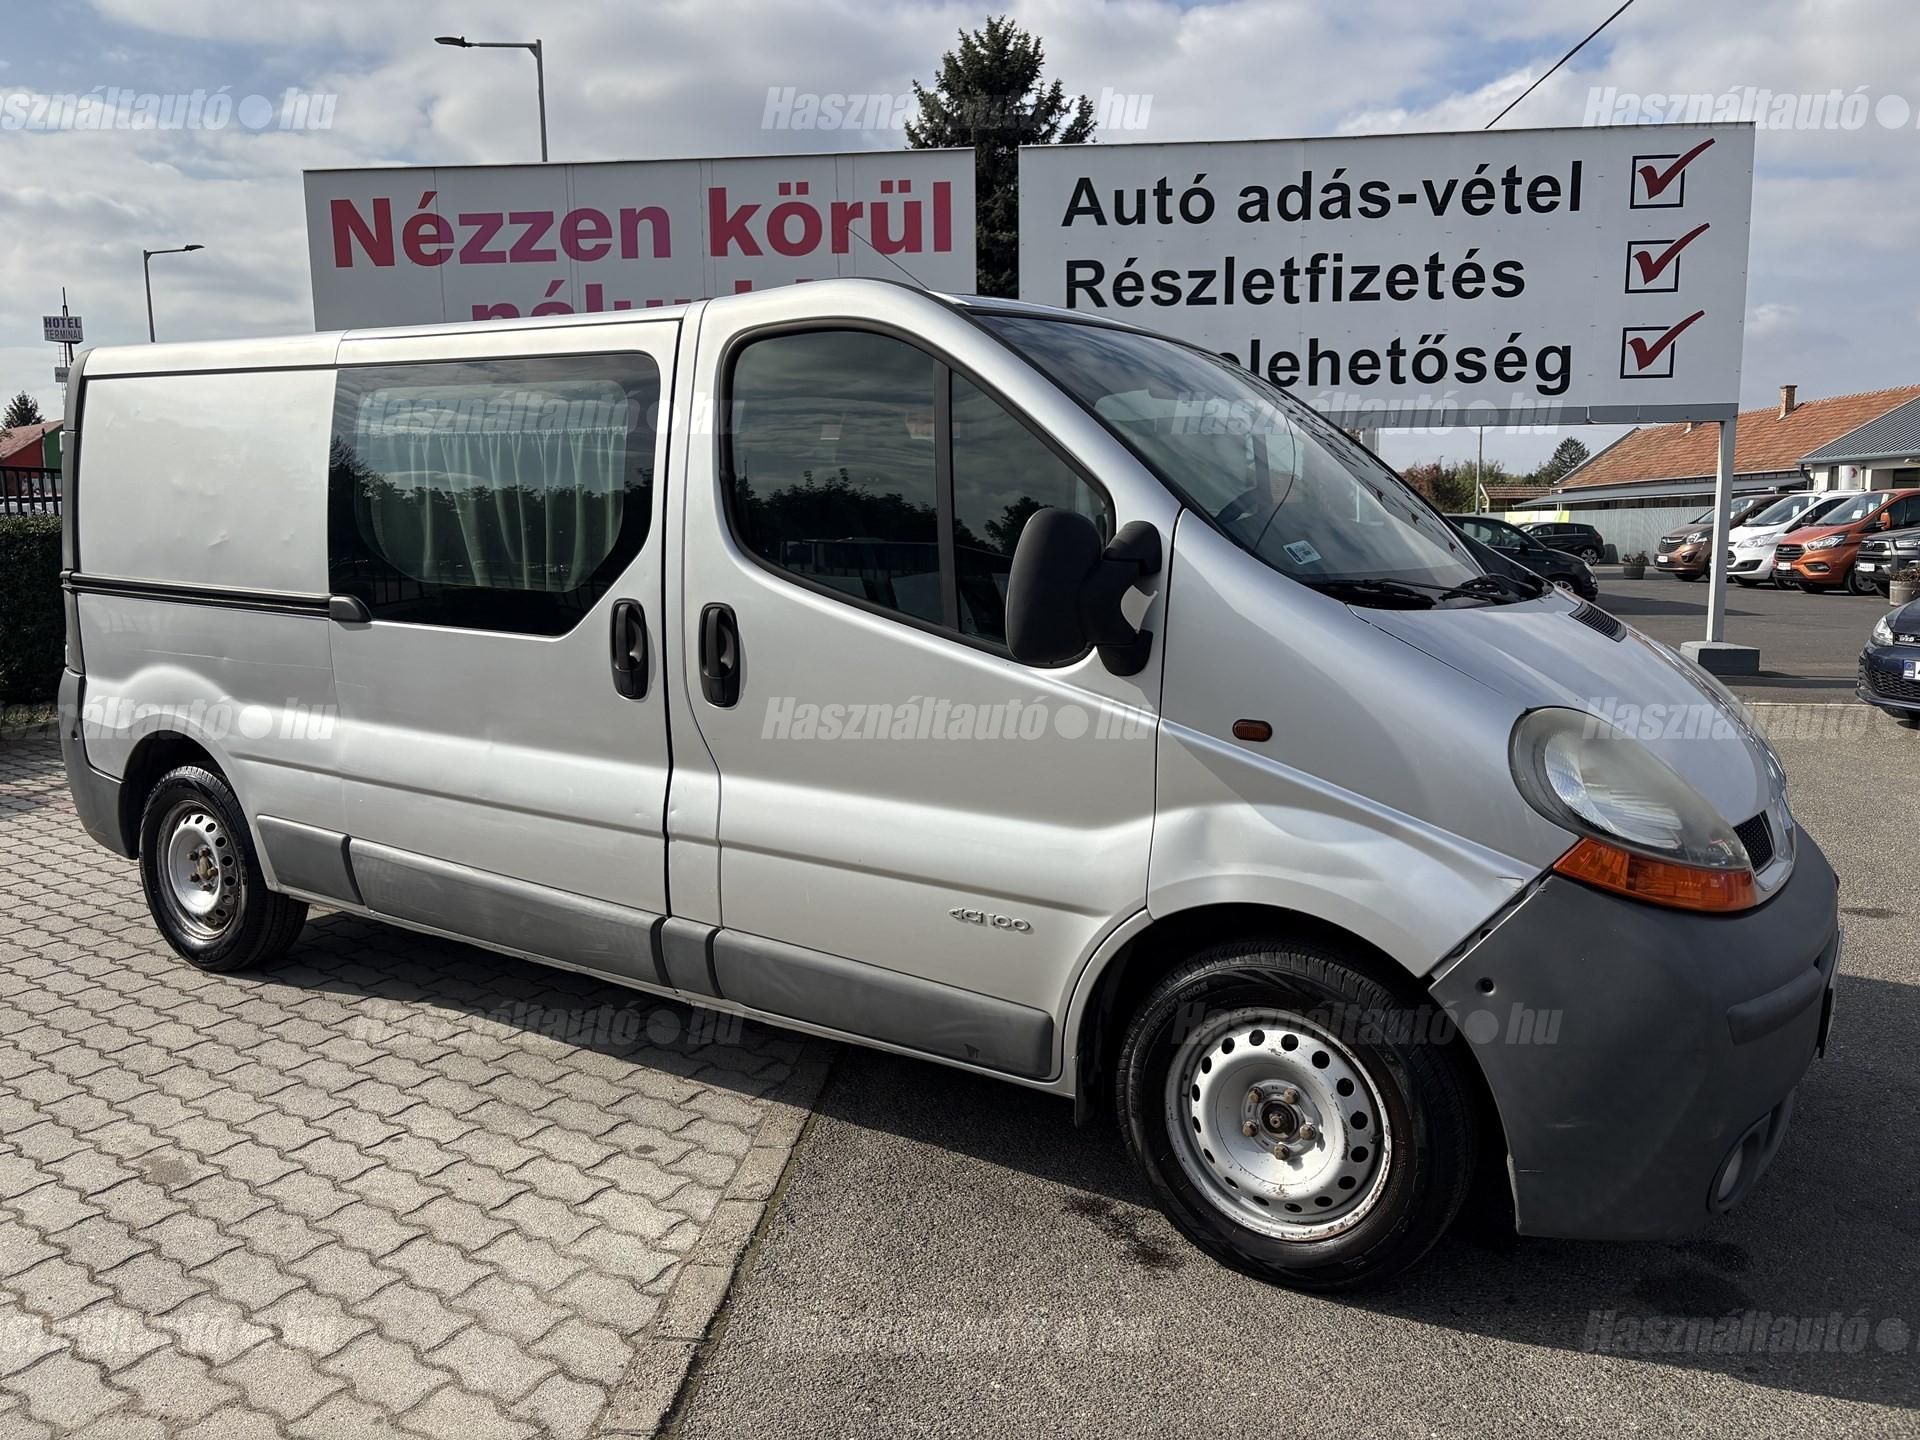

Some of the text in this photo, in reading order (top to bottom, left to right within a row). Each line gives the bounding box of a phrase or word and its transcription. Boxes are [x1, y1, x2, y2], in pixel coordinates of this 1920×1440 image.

[330, 179, 952, 268] Nézzen körül
[1061, 160, 1582, 227] Autó adás-vétel
[1066, 248, 1526, 309] Részletfizetés
[44, 317, 81, 328] HOTEL
[45, 329, 83, 340] TERMINAL
[1219, 332, 1571, 396] lehetőség
[987, 913, 1032, 932] 100
